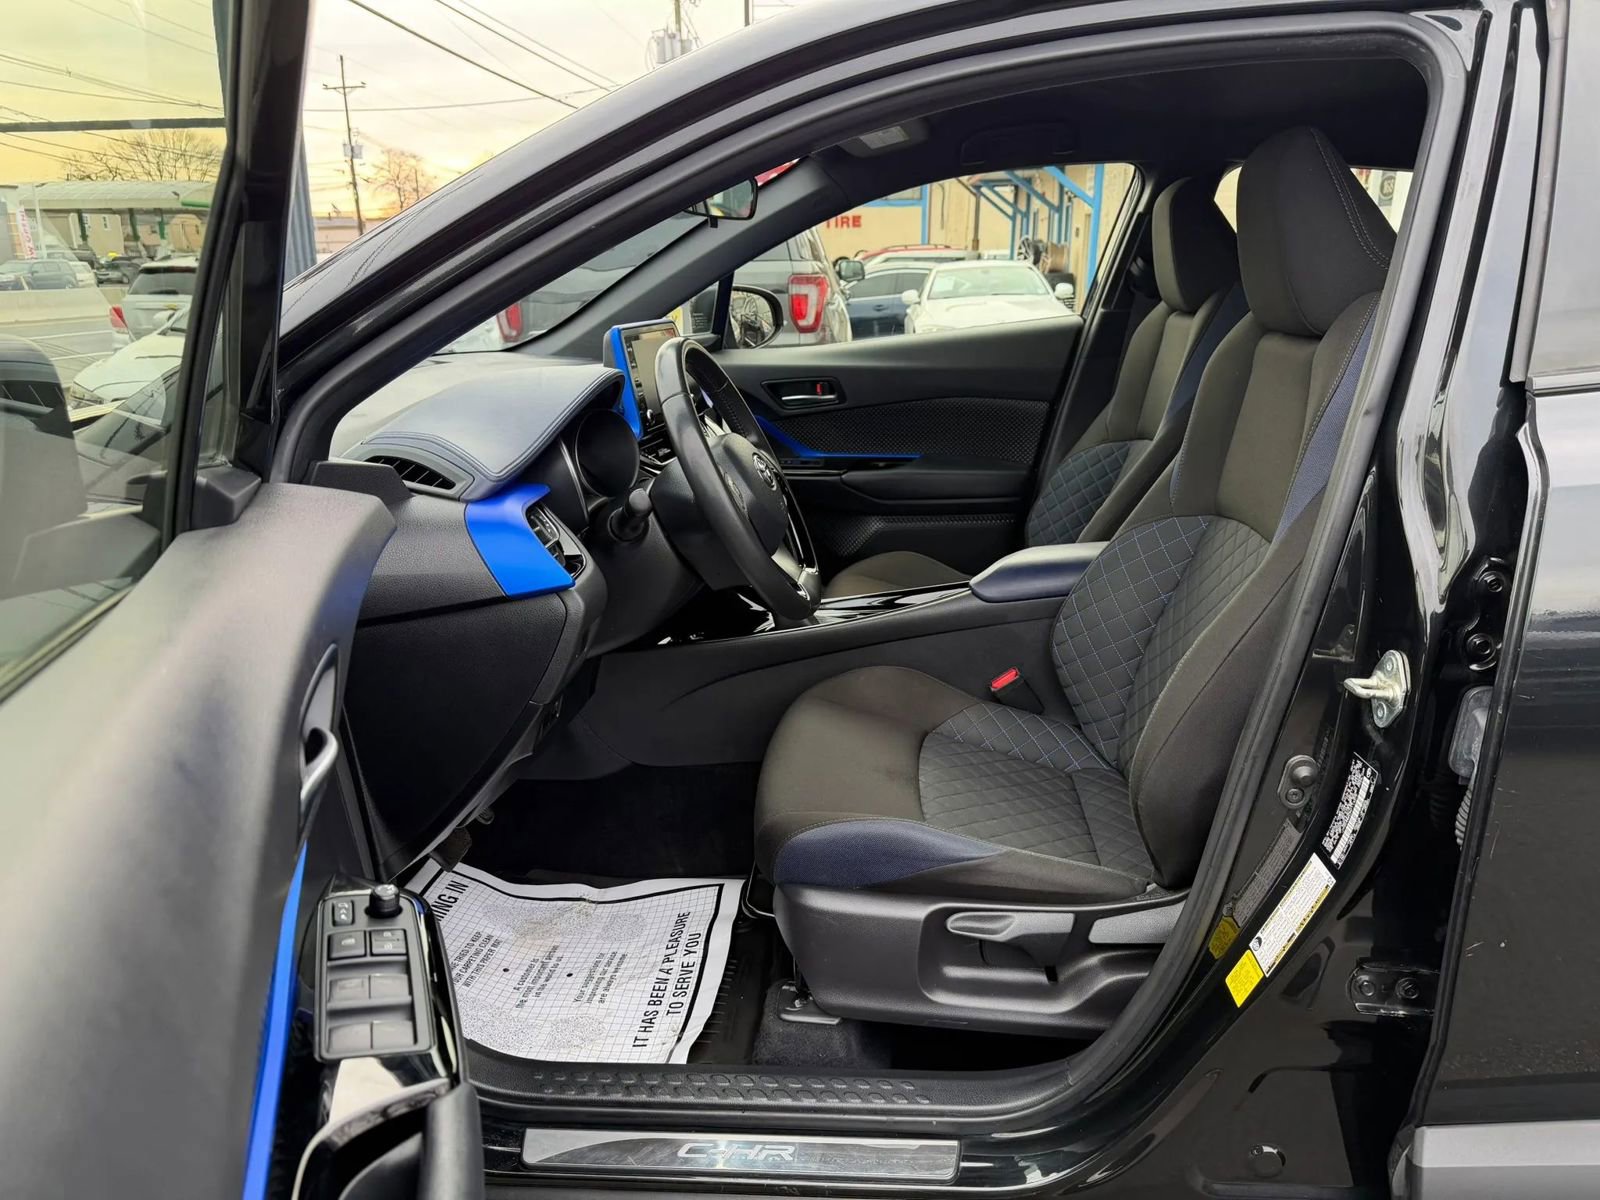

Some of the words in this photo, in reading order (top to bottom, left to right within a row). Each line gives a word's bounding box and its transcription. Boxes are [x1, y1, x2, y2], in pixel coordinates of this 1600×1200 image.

[444, 879, 469, 894] IN
[464, 942, 475, 950] TO
[662, 911, 691, 965] PLEASURE
[683, 932, 702, 957] YOU
[459, 947, 484, 974] CARPETING
[659, 967, 674, 976] A
[672, 961, 696, 999] SERVE
[648, 977, 671, 1007] BEEN
[666, 1001, 684, 1017] TO
[637, 1010, 660, 1033] HAS
[632, 1036, 650, 1048] IT
[677, 1142, 796, 1161] C-HR
